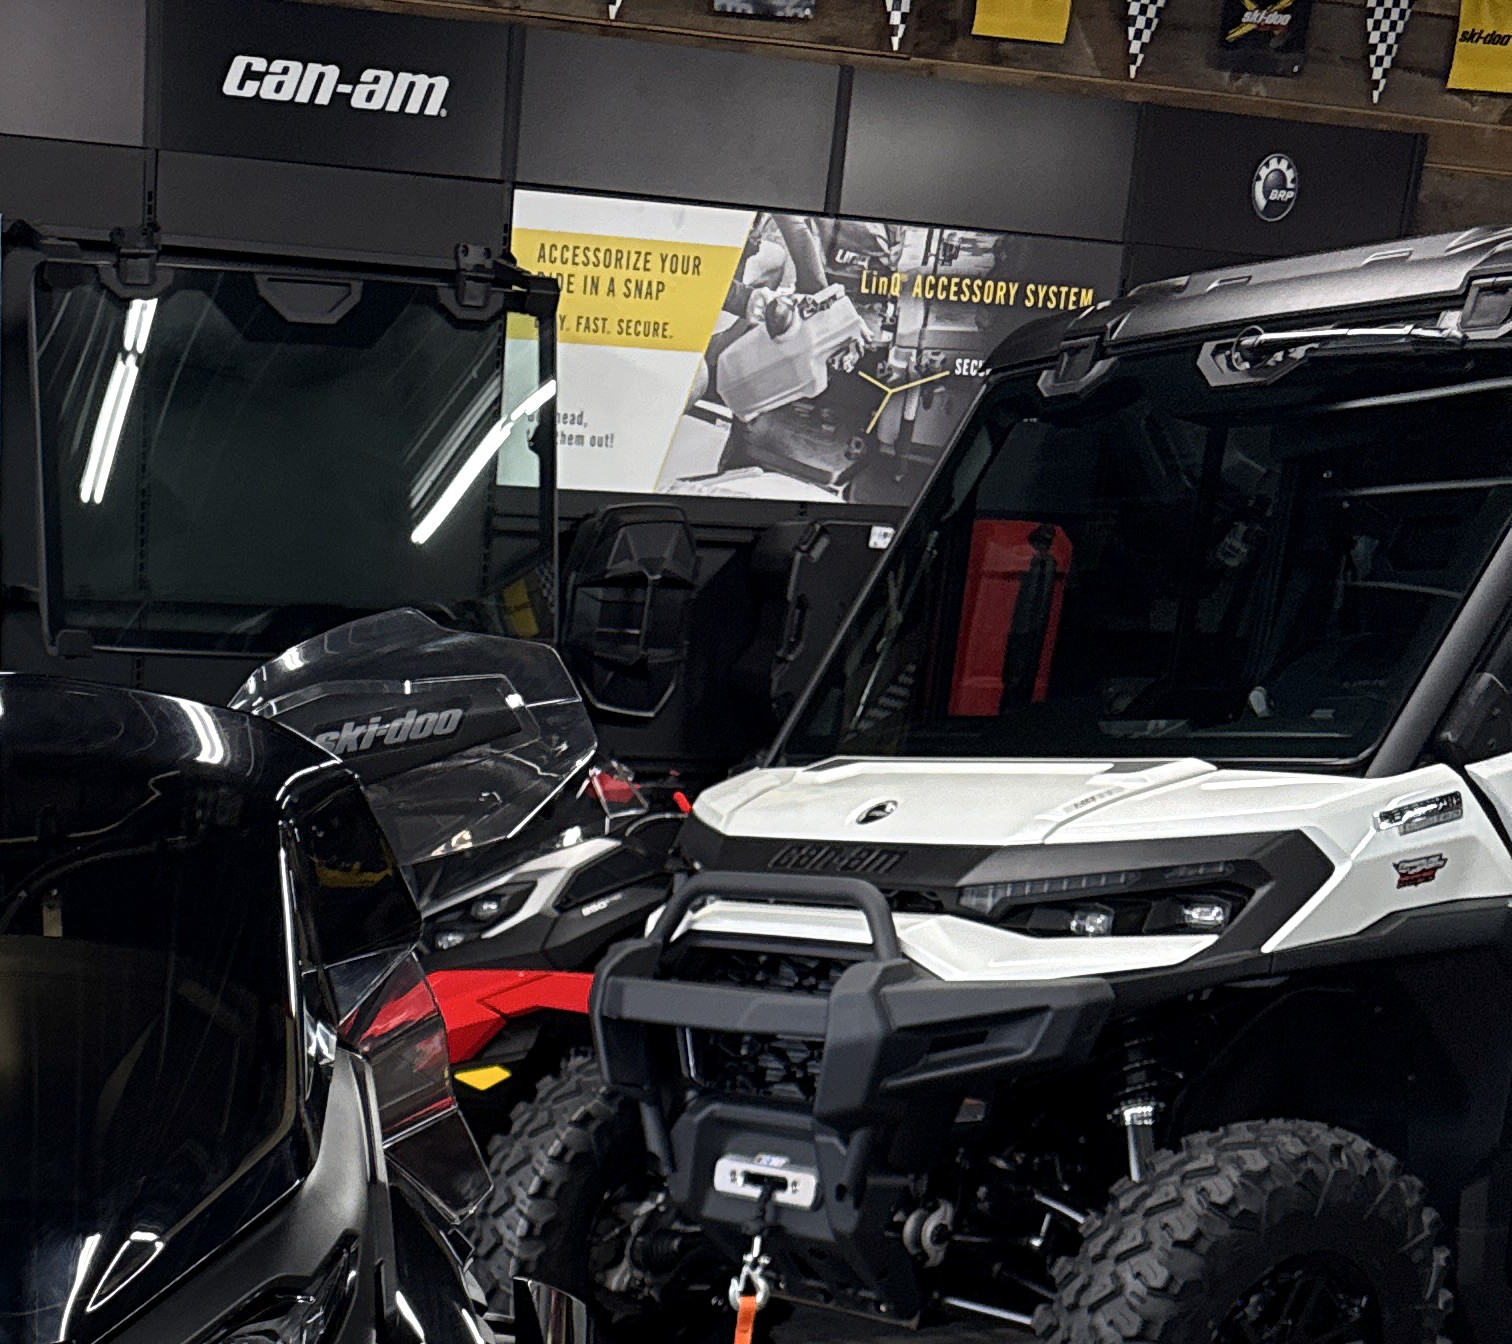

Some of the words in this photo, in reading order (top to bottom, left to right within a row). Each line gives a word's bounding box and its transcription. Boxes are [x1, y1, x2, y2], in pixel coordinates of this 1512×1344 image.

[222, 54, 450, 117] can-am
[1269, 188, 1294, 202] BRP
[537, 242, 651, 272] ACCESSORIZE
[660, 252, 702, 276] YOUR
[583, 275, 599, 296] IN
[606, 277, 616, 297] A
[624, 278, 665, 301] SNAP
[912, 274, 1019, 306] ACCESSORY
[1025, 284, 1094, 310] SYSTEM
[575, 315, 611, 334] FAST.
[617, 318, 674, 340] SECURE.
[589, 432, 614, 449] out!
[316, 708, 464, 752] ski-doo
